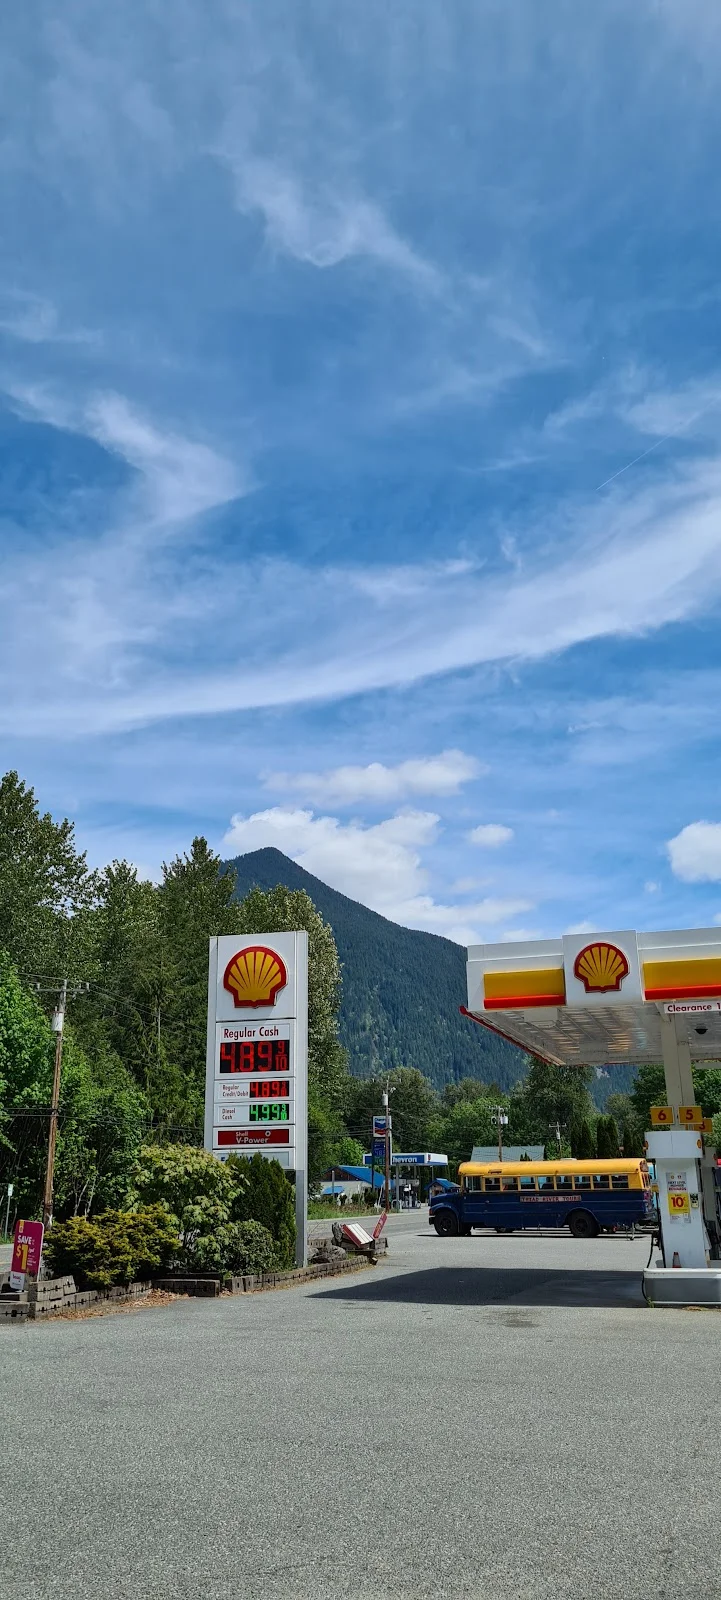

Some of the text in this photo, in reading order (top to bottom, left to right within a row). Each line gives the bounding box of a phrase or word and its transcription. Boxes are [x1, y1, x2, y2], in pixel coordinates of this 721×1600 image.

[224, 1026, 278, 1040] Regular Cash
[658, 1109, 694, 1120] 6 5
[18, 1235, 32, 1244] SAVE
